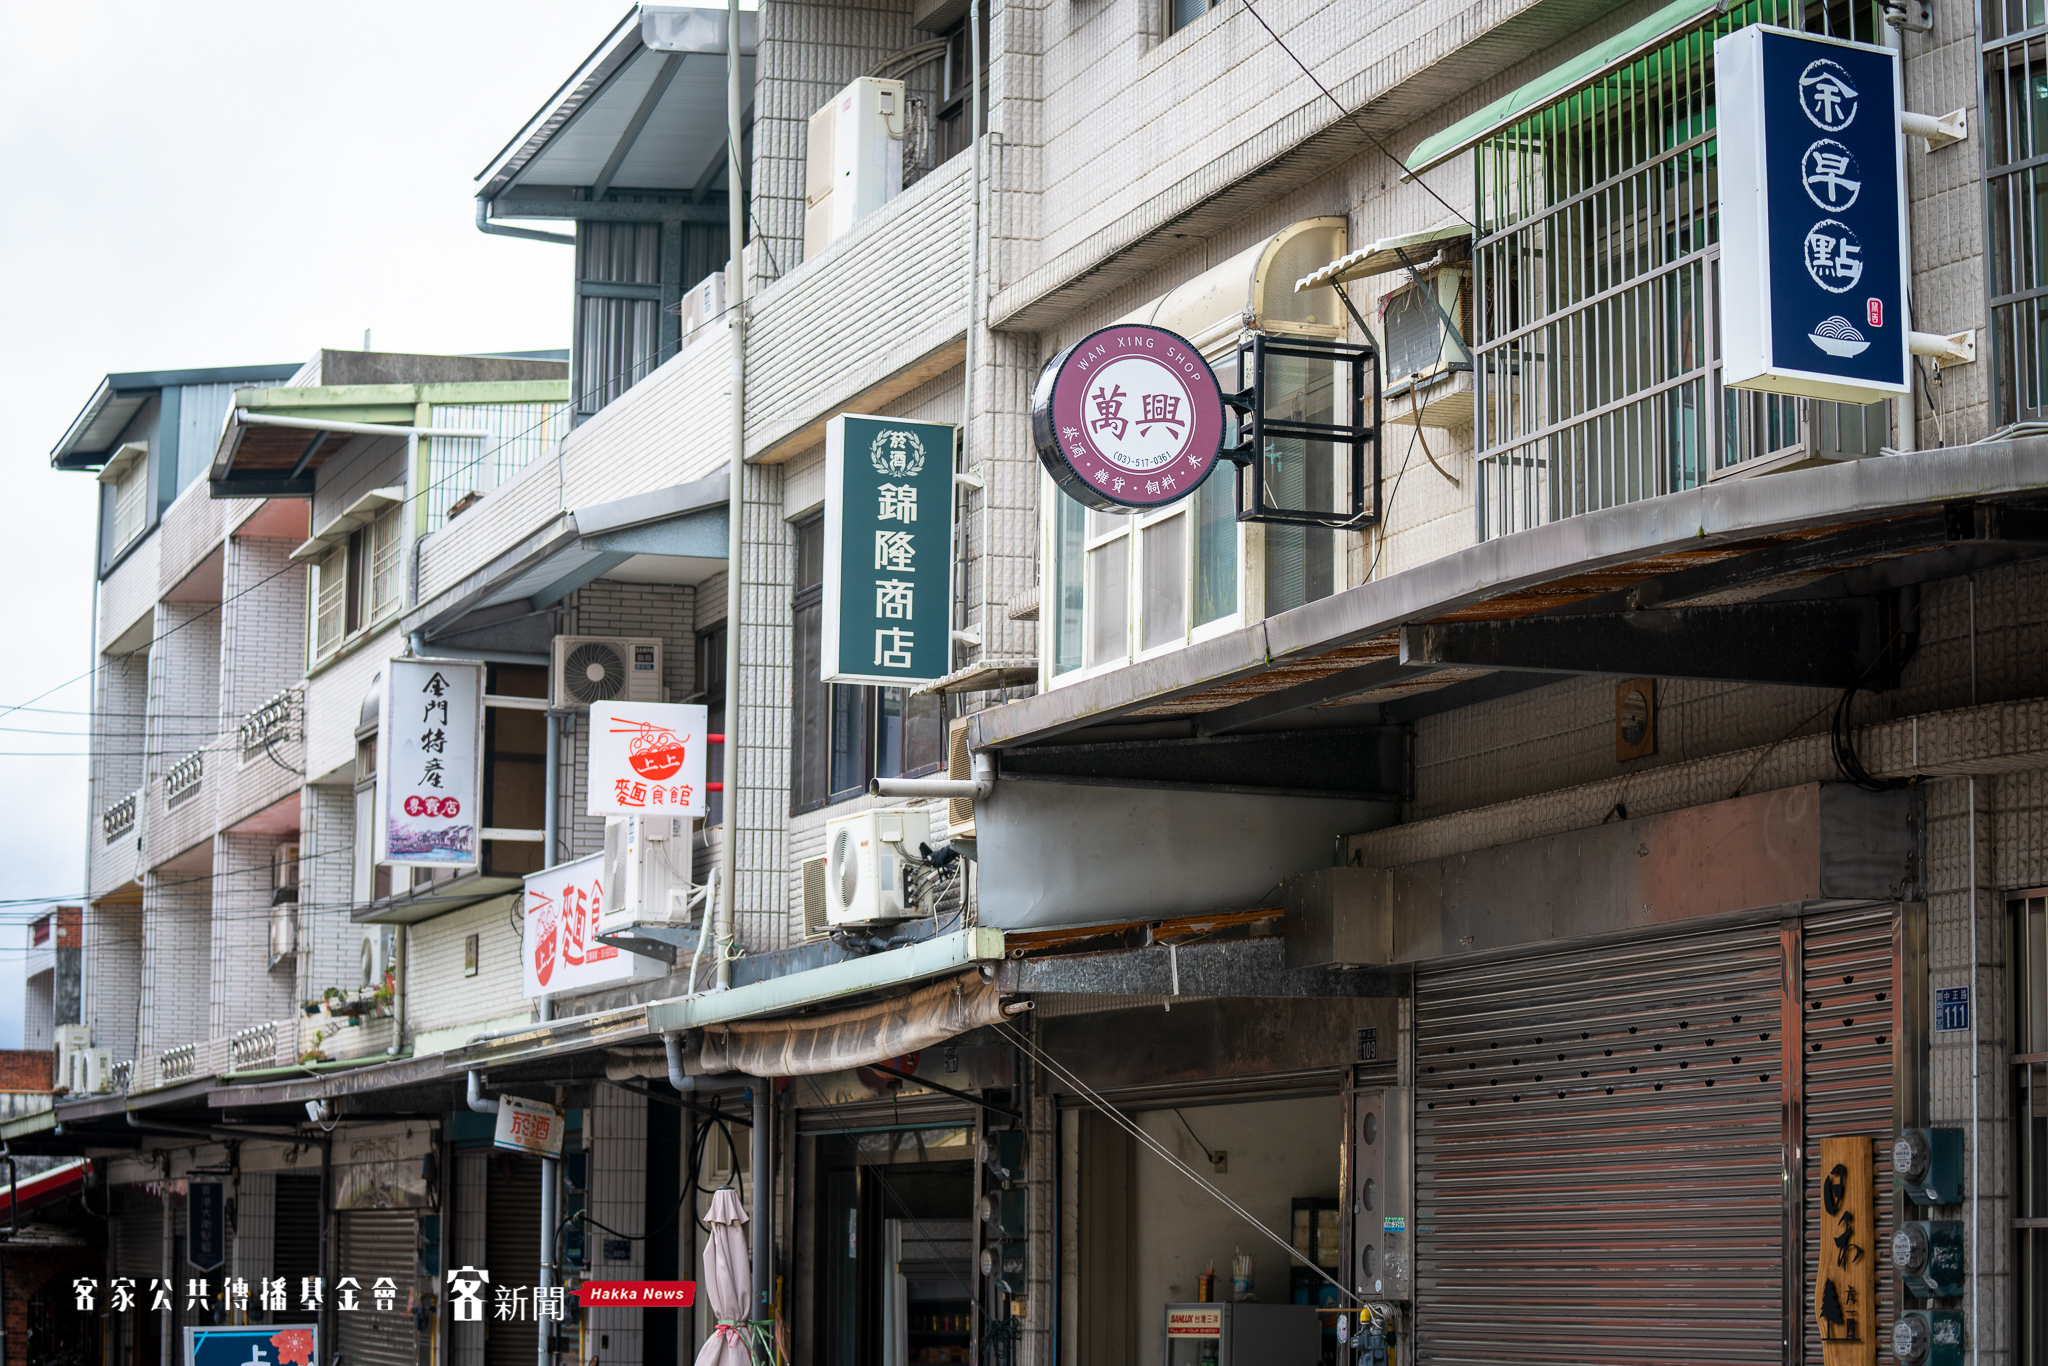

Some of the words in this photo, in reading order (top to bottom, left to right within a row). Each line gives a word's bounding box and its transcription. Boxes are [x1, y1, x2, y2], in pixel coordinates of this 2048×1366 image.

[1800, 72, 1863, 279] 余早點
[1077, 344, 1106, 371] WAN
[1117, 336, 1155, 349] XING
[1166, 346, 1201, 381] SHOP
[1091, 383, 1186, 442] 萬興
[889, 430, 907, 472] 菸酒
[1113, 450, 1172, 468] (03)-517-0361
[873, 482, 919, 669] 錦隆商店
[417, 671, 450, 789] 金門特產
[636, 750, 681, 771] 上上
[405, 796, 459, 816] 專賣店
[614, 778, 694, 808] 麵食館
[536, 942, 556, 975] 上上
[1944, 989, 1967, 1002] 中正路
[1944, 1004, 1965, 1029] 111
[1362, 1041, 1376, 1060] 109
[510, 1110, 552, 1141] 菸酒
[1170, 1314, 1194, 1324] SANLUX
[1194, 1314, 1219, 1324] 台灣三洋
